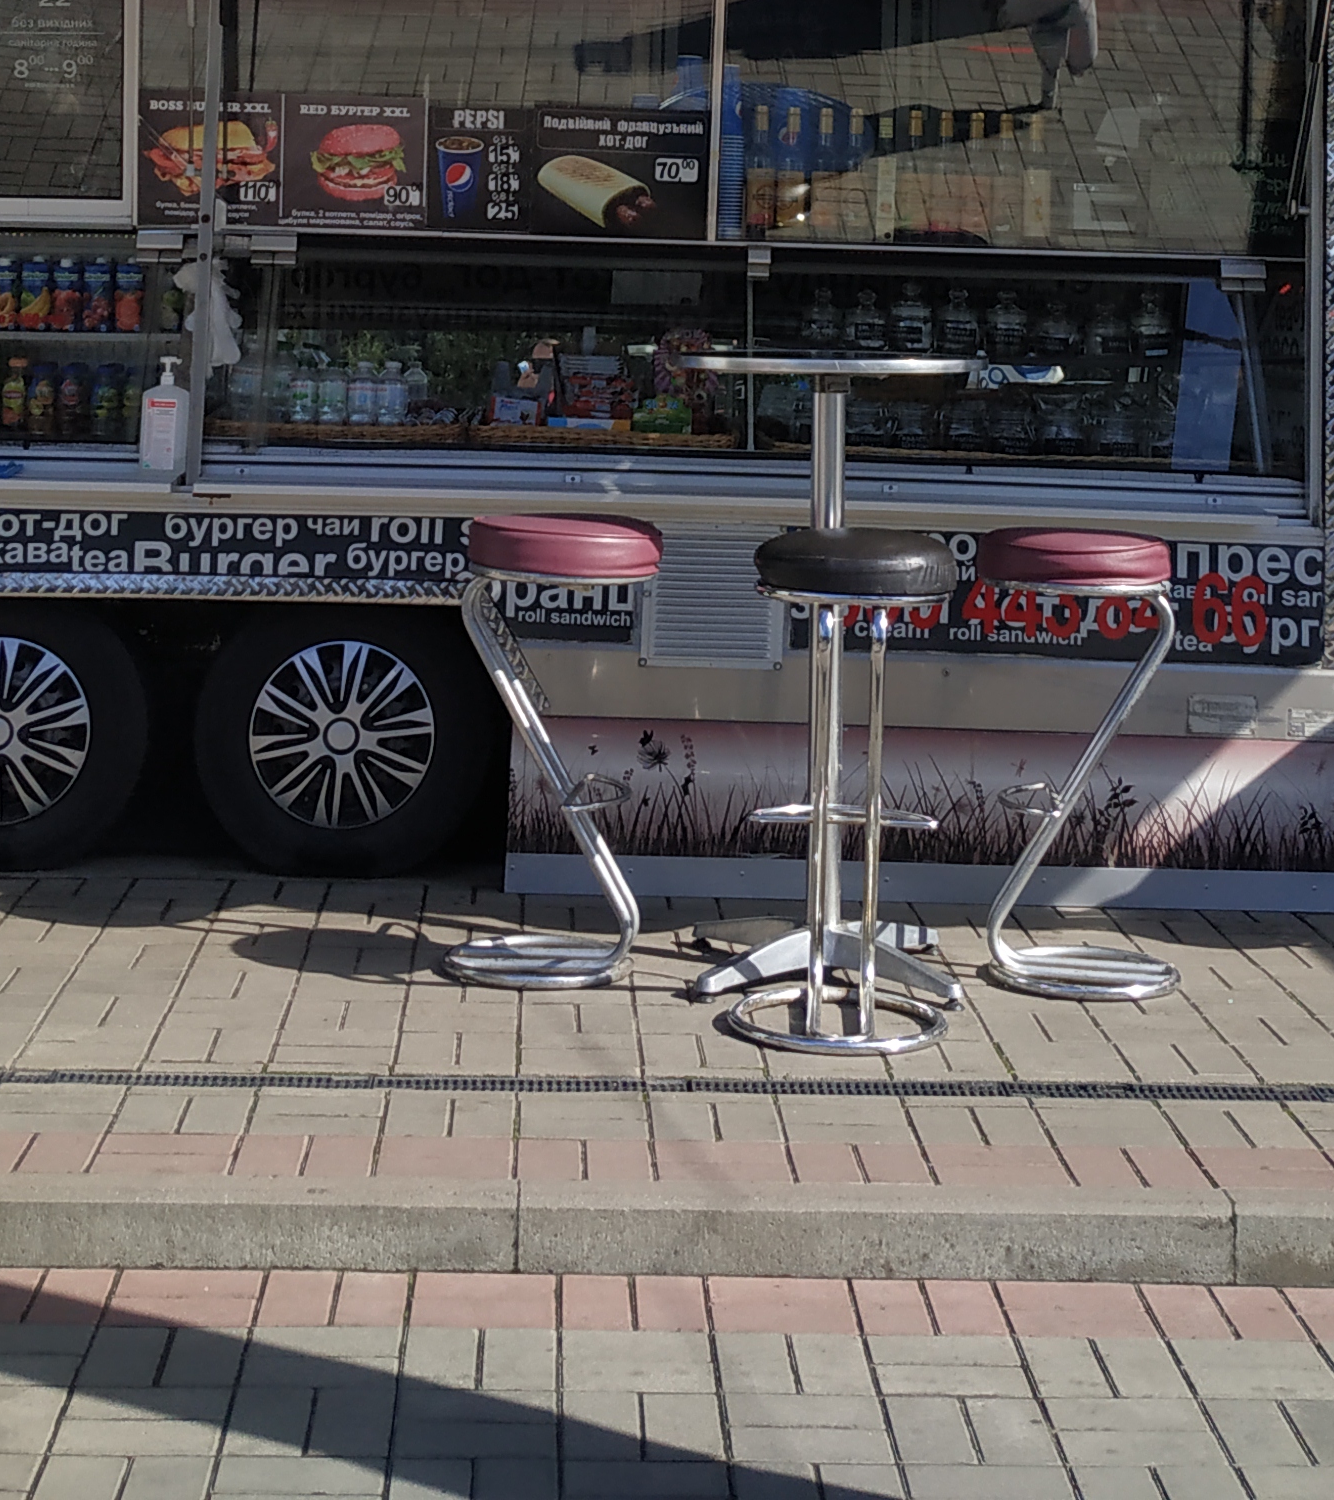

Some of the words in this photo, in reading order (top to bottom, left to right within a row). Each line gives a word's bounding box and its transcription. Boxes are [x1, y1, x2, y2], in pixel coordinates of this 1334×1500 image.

[149, 100, 183, 111] BOSS
[244, 103, 271, 113] XXL
[300, 104, 327, 115] RED
[331, 106, 380, 116] БУРГЕР
[383, 107, 410, 117] XXL
[453, 109, 505, 129] PEPSI
[543, 115, 611, 130] Подвійний
[617, 121, 704, 136] французький
[1193, 572, 1267, 648] 66
